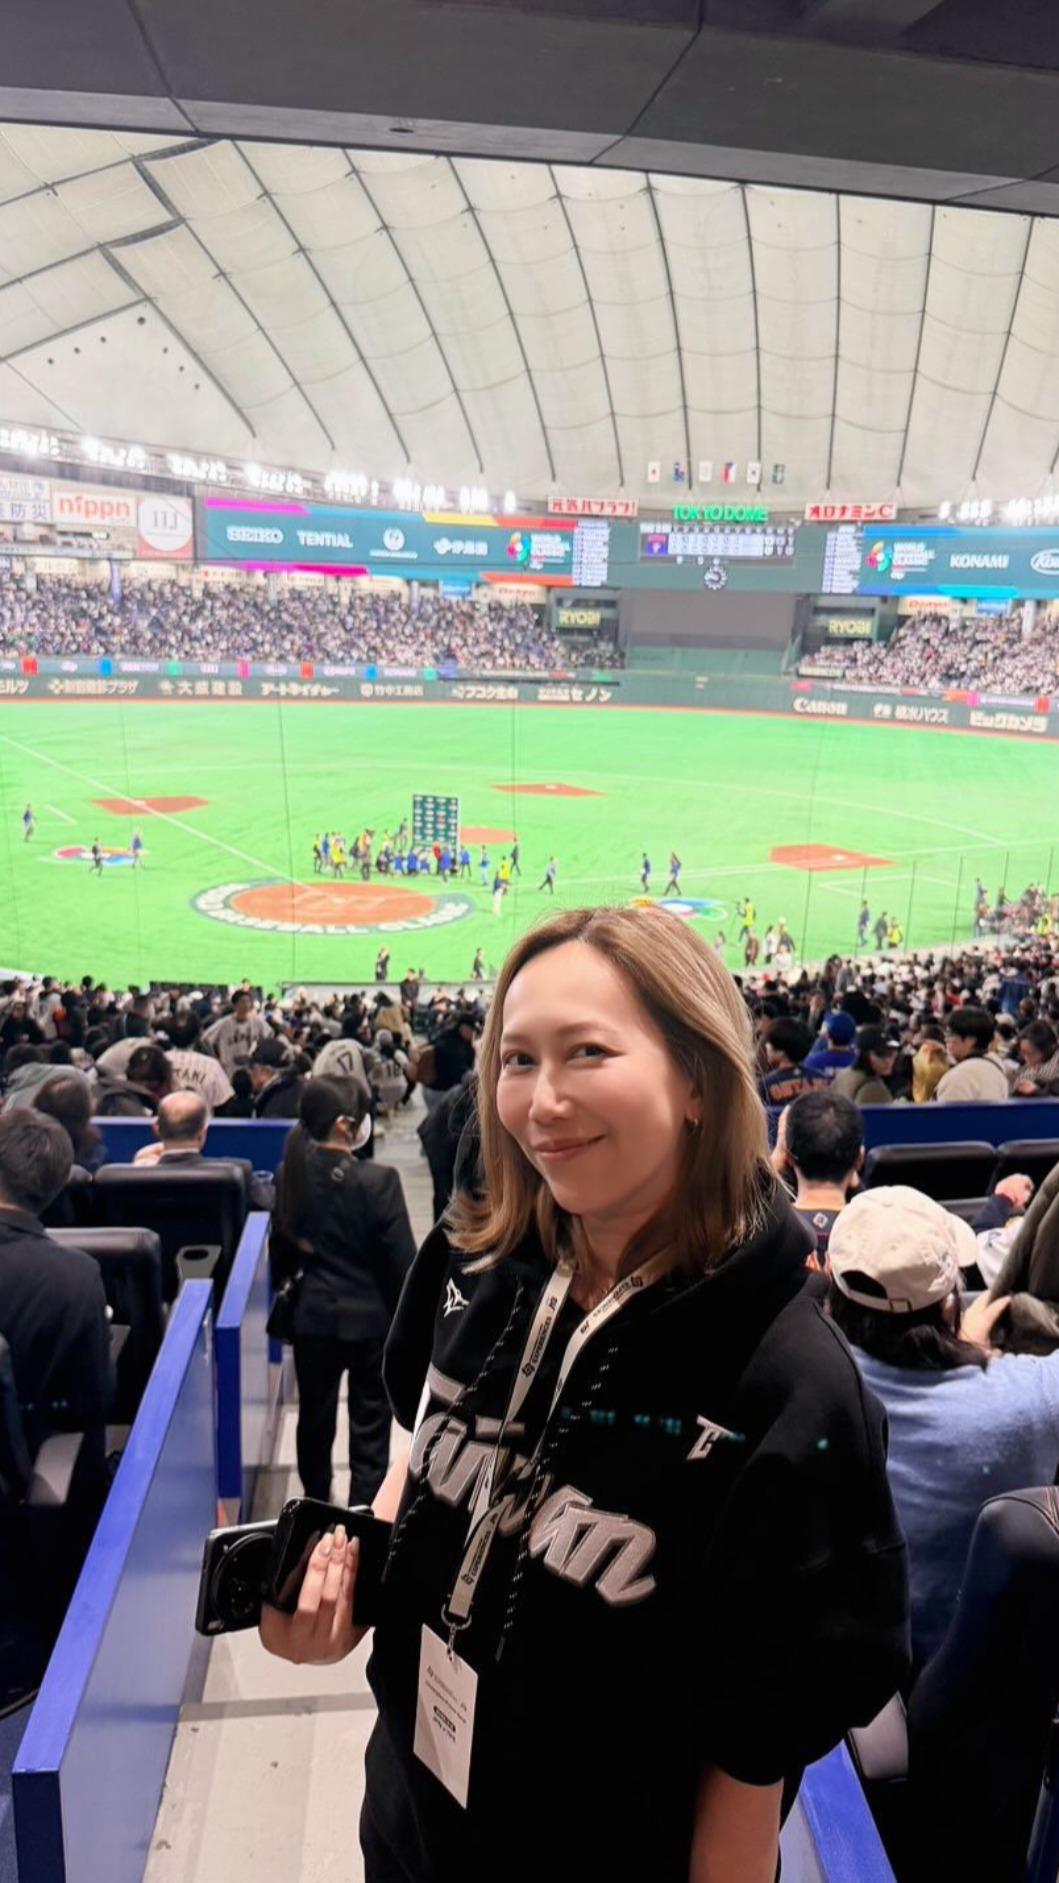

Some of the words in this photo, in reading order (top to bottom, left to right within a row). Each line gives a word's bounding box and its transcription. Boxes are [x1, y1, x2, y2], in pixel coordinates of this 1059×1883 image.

[59, 496, 130, 519] nippn
[297, 530, 353, 548] TENTIAL
[950, 553, 1009, 569] KONAMI
[559, 610, 601, 625] RYOBI
[829, 619, 872, 635] RYOBI
[793, 698, 848, 716] Canon
